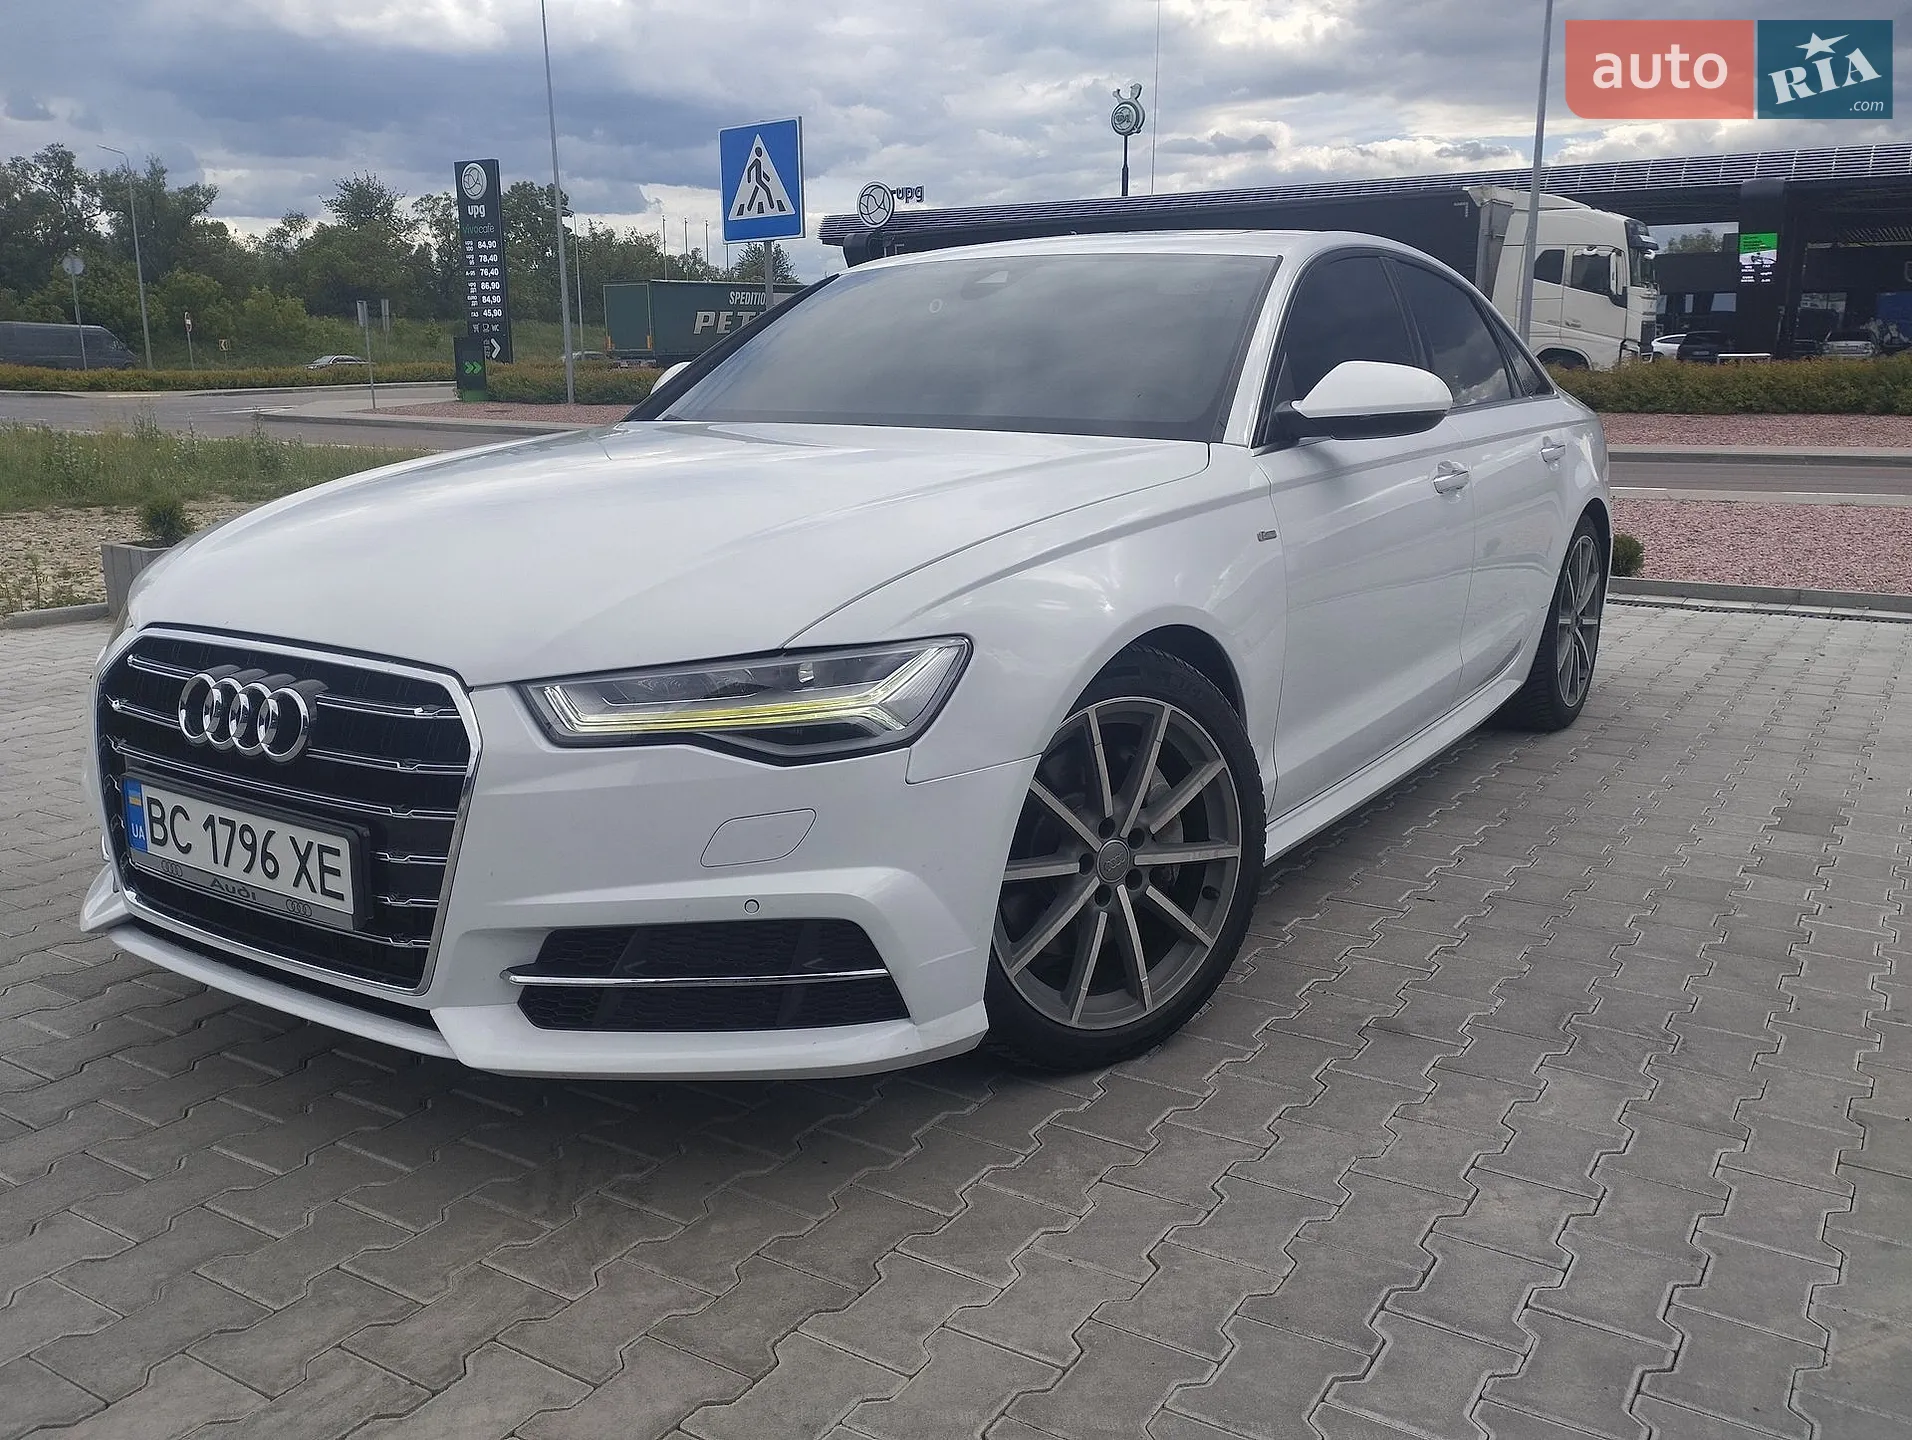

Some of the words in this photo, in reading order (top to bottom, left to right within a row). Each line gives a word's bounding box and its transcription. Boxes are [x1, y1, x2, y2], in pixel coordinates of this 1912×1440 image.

[896, 185, 925, 204] upg
[467, 204, 486, 219] upg
[477, 240, 497, 250] 84,90
[729, 291, 767, 306] SPEDITIO
[482, 308, 503, 319] 45,90
[693, 311, 765, 335] PET
[131, 823, 146, 840] UA
[146, 795, 192, 855] BC
[202, 814, 280, 880] 1796
[289, 835, 345, 901] XE
[210, 877, 257, 901] Audi
